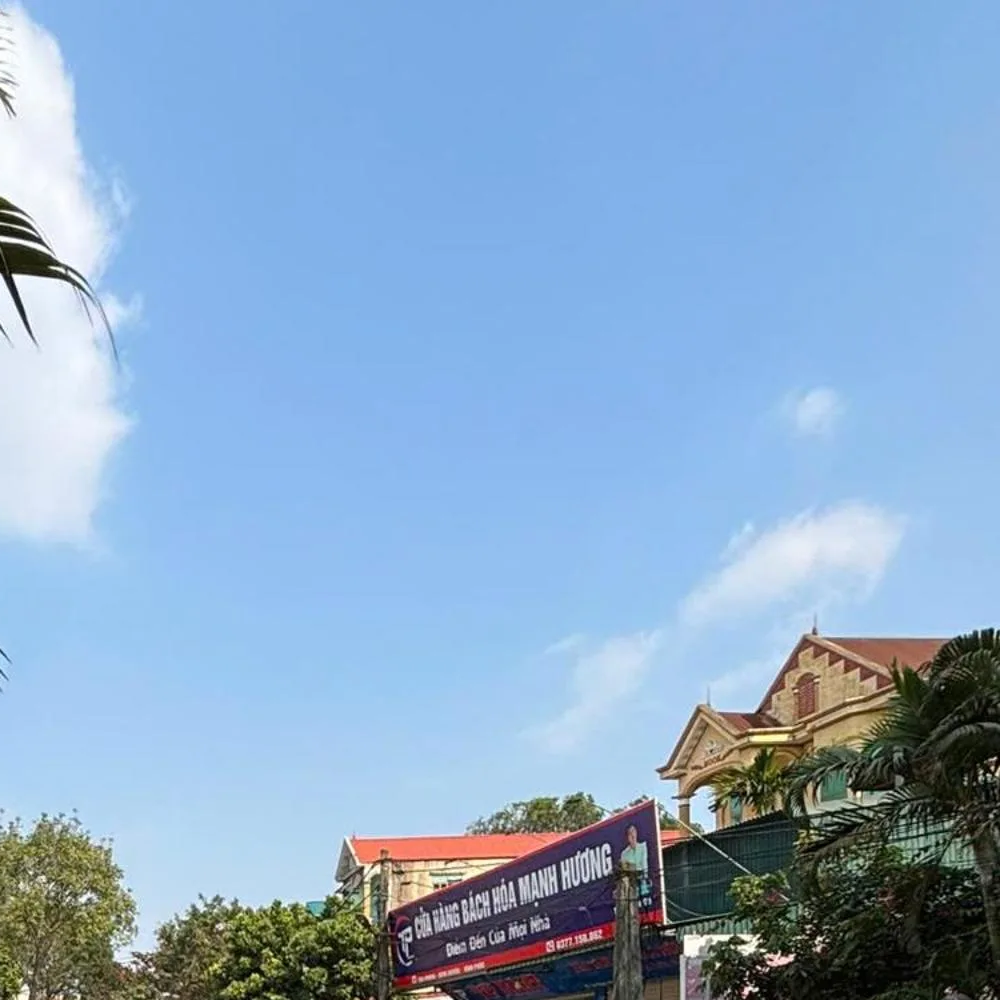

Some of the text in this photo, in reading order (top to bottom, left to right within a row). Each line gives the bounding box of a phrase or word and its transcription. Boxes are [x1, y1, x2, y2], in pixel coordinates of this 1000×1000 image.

[414, 842, 613, 940] CỬA HÀNG BÁCH HÓA MẠNH HƯƠNG
[508, 920, 528, 941] Mọi
[529, 914, 551, 935] Nhà
